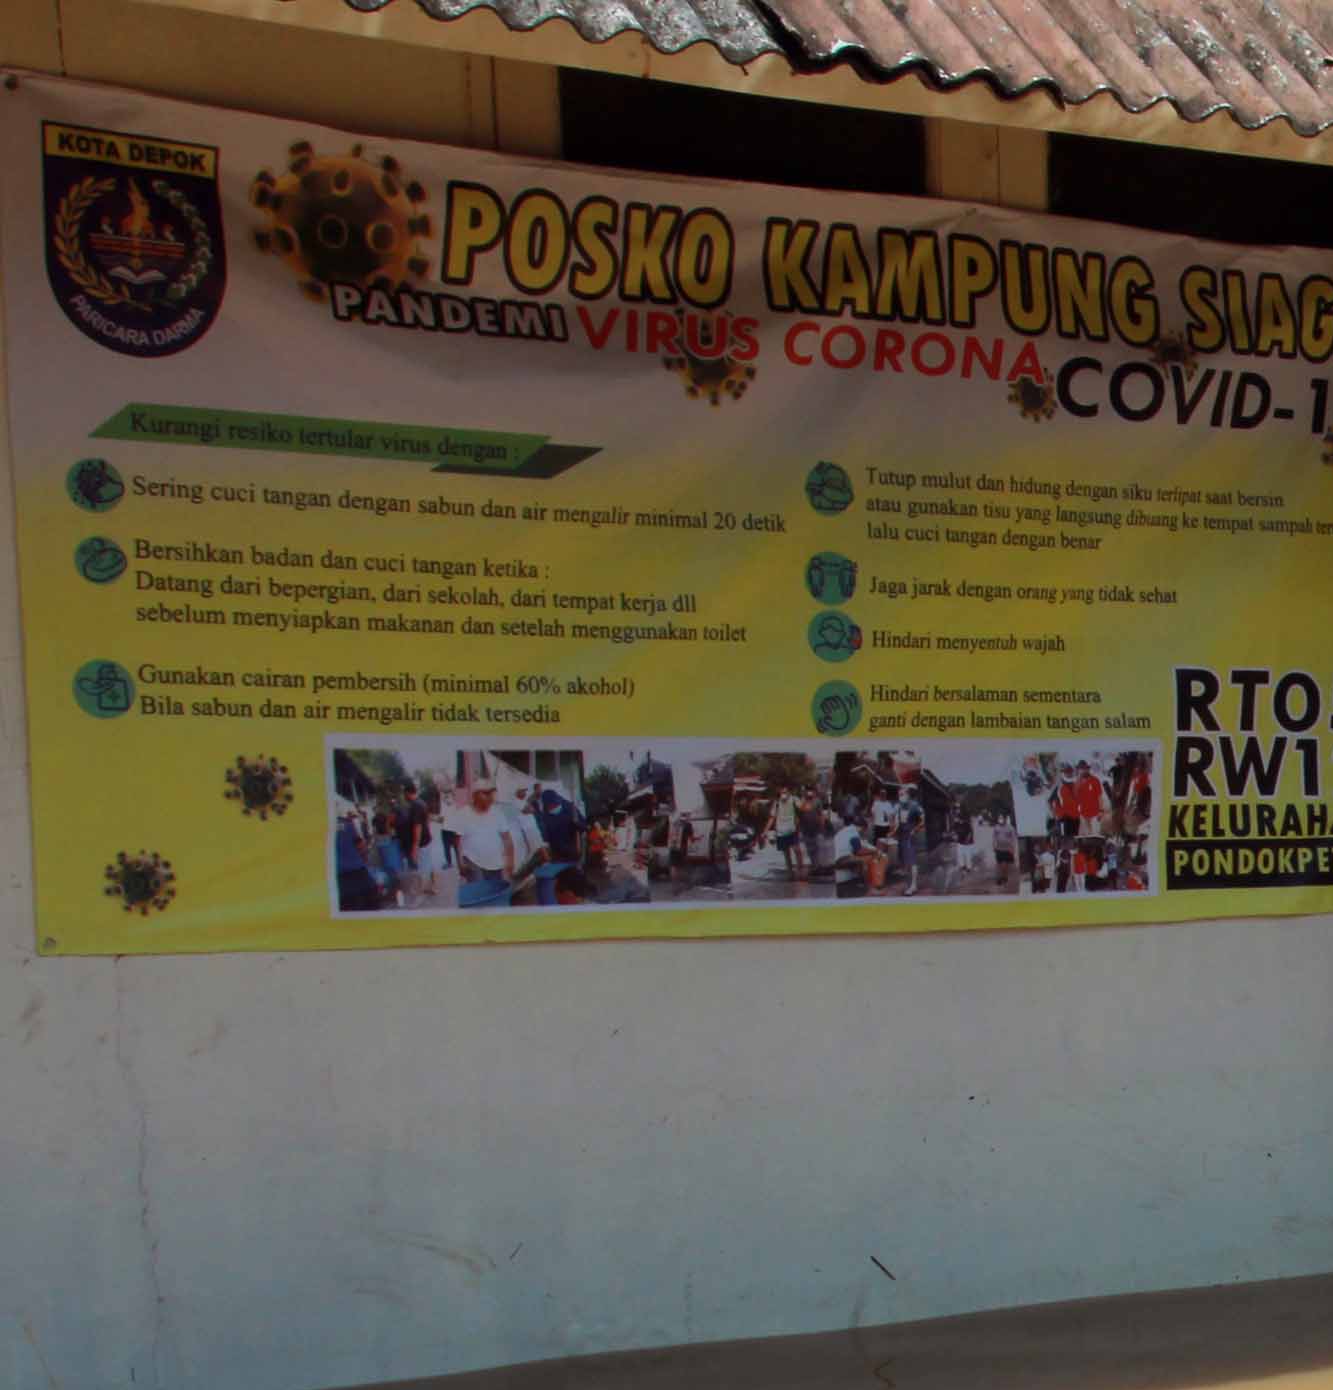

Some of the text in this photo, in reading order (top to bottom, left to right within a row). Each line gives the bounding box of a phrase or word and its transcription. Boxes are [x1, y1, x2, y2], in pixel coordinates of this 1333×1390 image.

[58, 133, 208, 171] KOTA DEPOK
[441, 180, 736, 310] POSKO
[763, 217, 1163, 346] KAMPUNG
[330, 283, 568, 342] PANDEMI
[576, 305, 761, 361] VIRUS
[784, 321, 1046, 386] CORONA
[129, 412, 222, 443] Kurangi
[229, 421, 293, 444] resiko
[299, 426, 374, 452] tertular
[380, 432, 431, 456] virus
[437, 436, 507, 462] dengan
[132, 477, 786, 533] Sering cuci tangan dengan sabun dan air mengalir minimal 20 detik
[866, 467, 917, 490] Tutup
[921, 471, 971, 490] mulut
[976, 474, 1004, 492] dan
[1010, 475, 1061, 498] hidung
[1065, 481, 1118, 501] dengan
[1122, 483, 1152, 501] siku
[1205, 491, 1232, 505] saat
[1237, 491, 1285, 507] bersin
[866, 498, 901, 513] atau
[907, 497, 977, 519] gunakan
[983, 504, 1010, 519] tisu
[1015, 506, 1051, 523] yang
[1056, 506, 1121, 528] langsung
[1126, 509, 1177, 531] dibuang
[1182, 514, 1198, 529] ke
[1203, 515, 1253, 535] tempat
[1259, 519, 1313, 536] sampah
[867, 523, 1102, 551] lalu cuci tangan dengan benar
[135, 538, 243, 565] Bersihkan
[250, 543, 313, 569] badan
[320, 547, 357, 570] dan
[364, 552, 405, 573] cuci
[412, 555, 476, 580] tangan
[483, 558, 538, 578] ketika
[136, 570, 697, 616] Datang dari bepergian, dari sekolah, dari tempat kerja dll
[870, 576, 1177, 604] Jaga jarak dengan orang yang tidak sehat
[136, 603, 746, 644] sebelum menyiapkan makanan dan setelah menggunakan toilet
[871, 630, 1065, 655] Hindari menyentuh wajah
[137, 663, 635, 697] Gunakan cairan pembersih (minimal 60% akohol)
[870, 685, 1102, 704] Hindari bersalaman sementara
[140, 695, 560, 725] Bila sabun dan air mengalir tidak tersedia
[868, 712, 1151, 733] ganti dengan lambaian tangan salam
